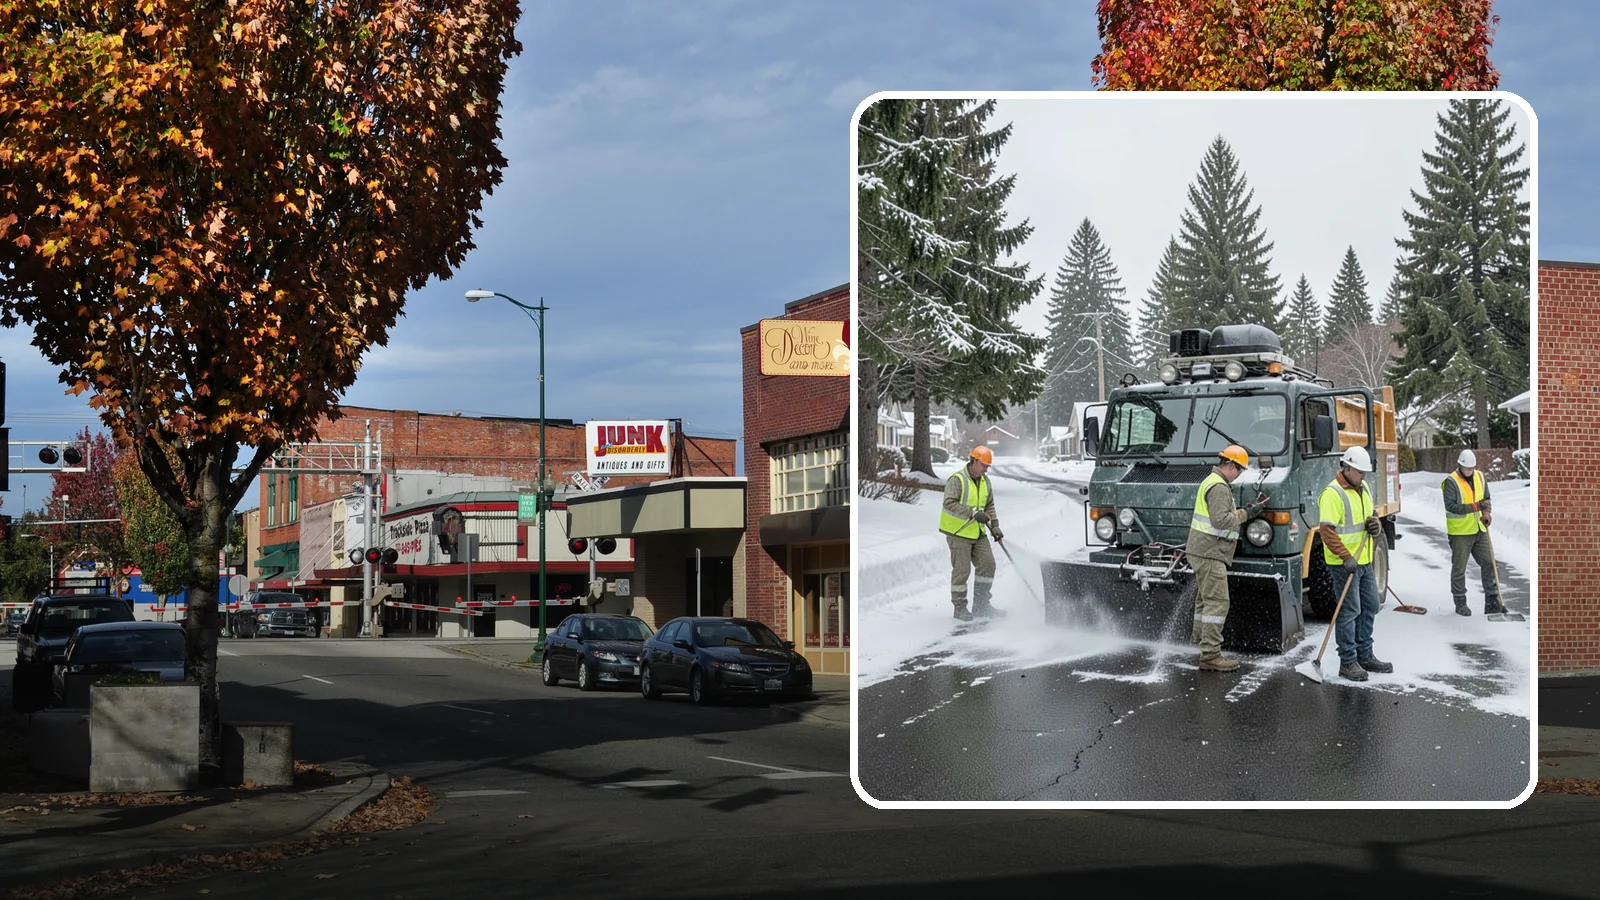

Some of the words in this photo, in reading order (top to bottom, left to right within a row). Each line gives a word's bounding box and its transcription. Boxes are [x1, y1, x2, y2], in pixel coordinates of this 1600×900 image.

[595, 425, 665, 457] JUNK
[607, 446, 646, 454] DISORDERLY
[597, 461, 627, 470] ANTIQUES
[631, 461, 644, 470] AND
[647, 460, 665, 469] GIFTS
[590, 476, 608, 492] SING
